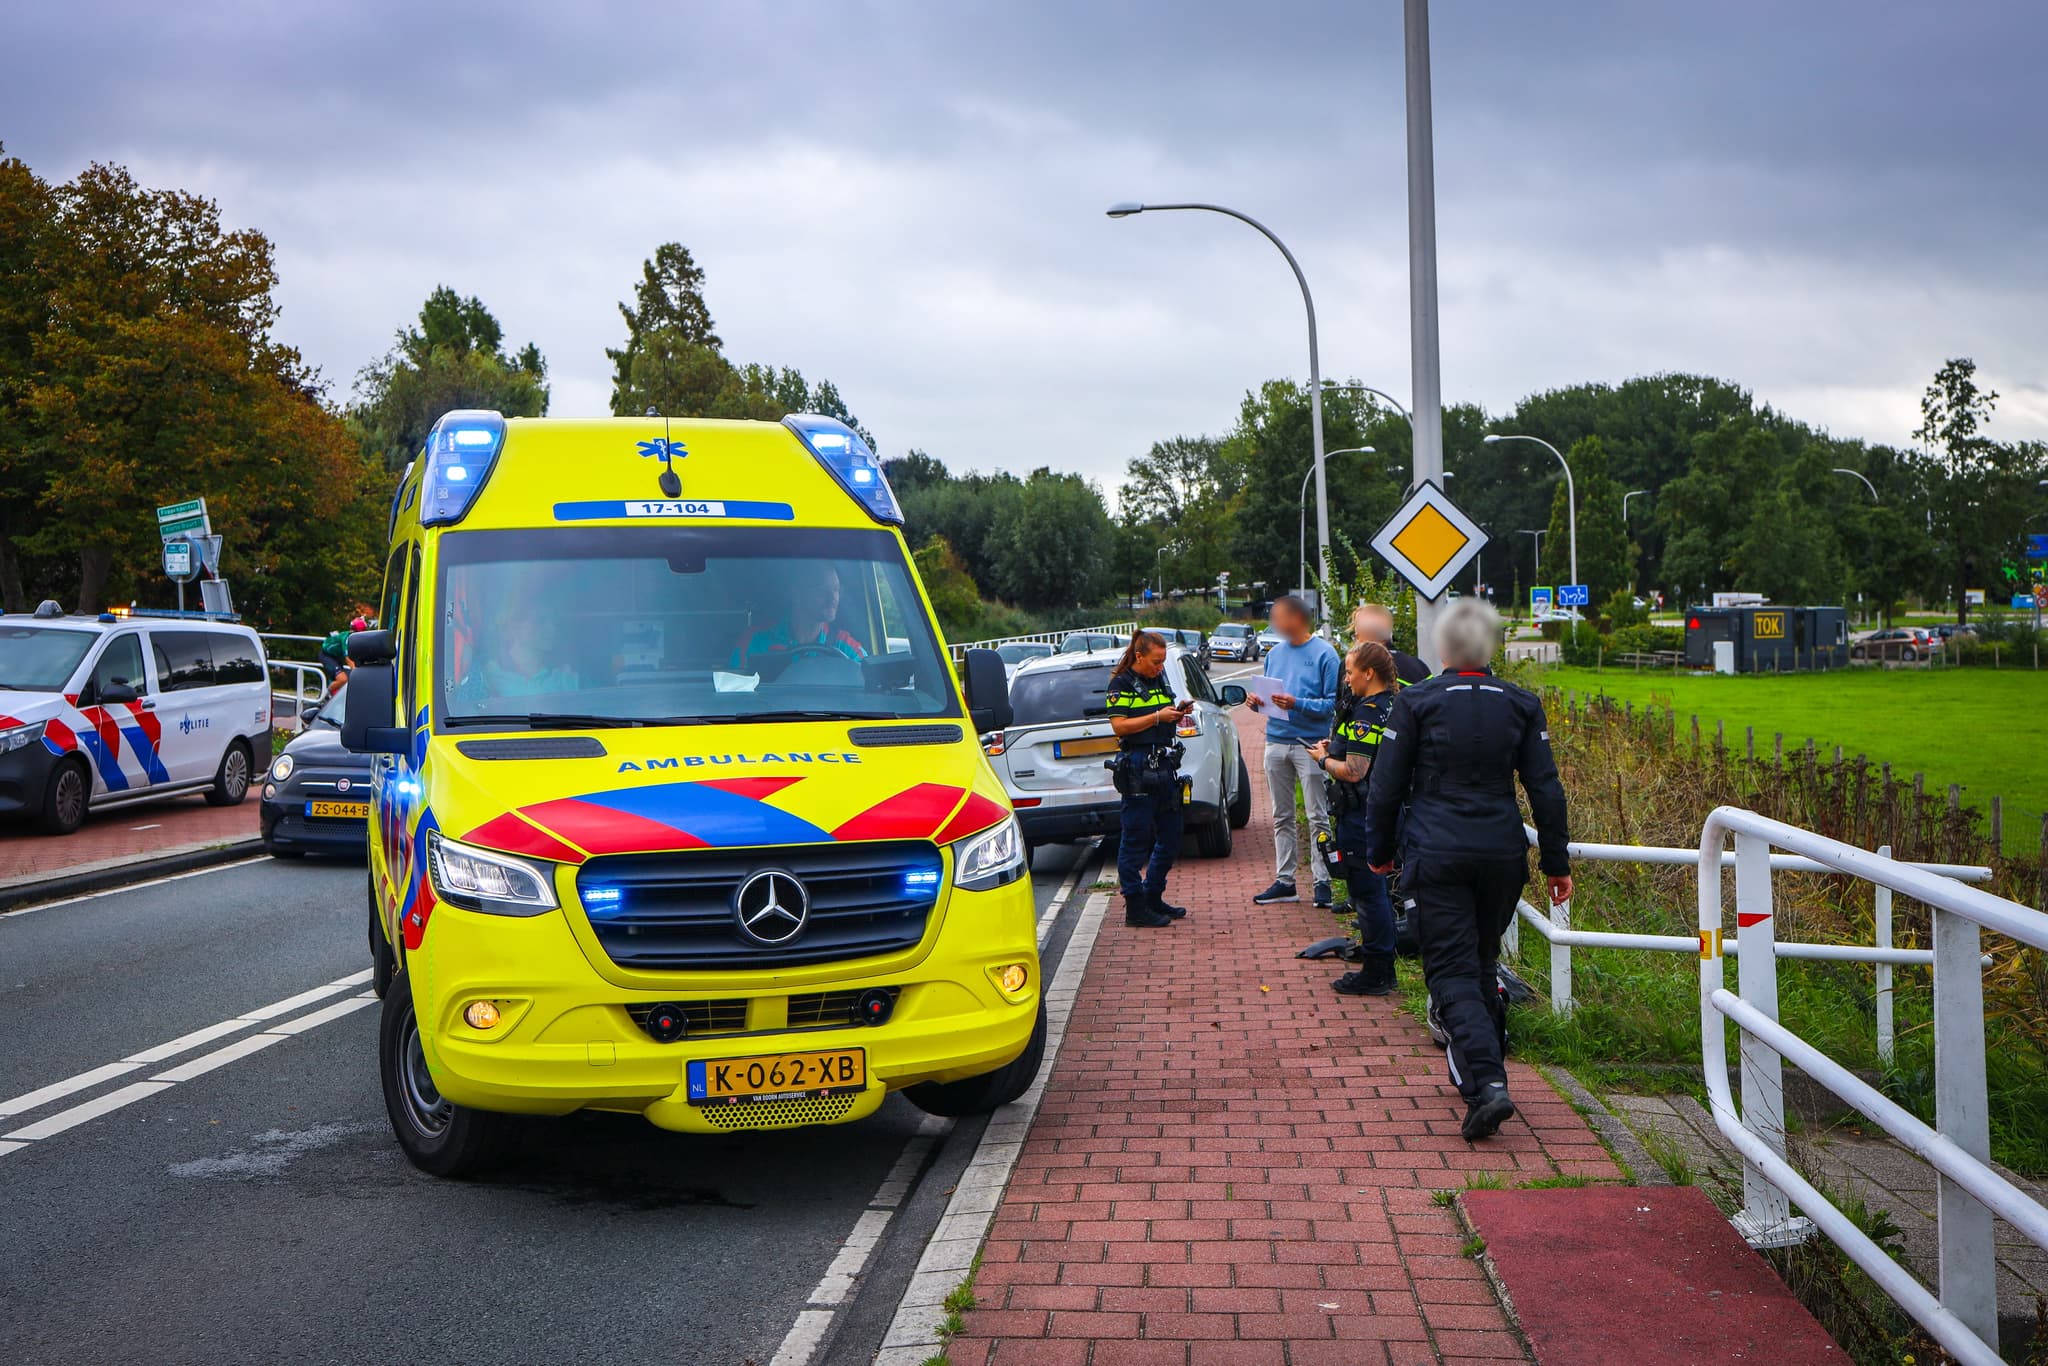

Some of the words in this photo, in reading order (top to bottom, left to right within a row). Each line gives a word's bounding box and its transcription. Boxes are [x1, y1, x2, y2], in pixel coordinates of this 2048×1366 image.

[641, 503, 710, 514] 17-104
[1756, 617, 1780, 635] TOK
[617, 752, 863, 773] AMBULANCE
[314, 803, 369, 816] ZS-044-B
[692, 1083, 705, 1093] NL
[715, 1055, 855, 1092] K-062-XB
